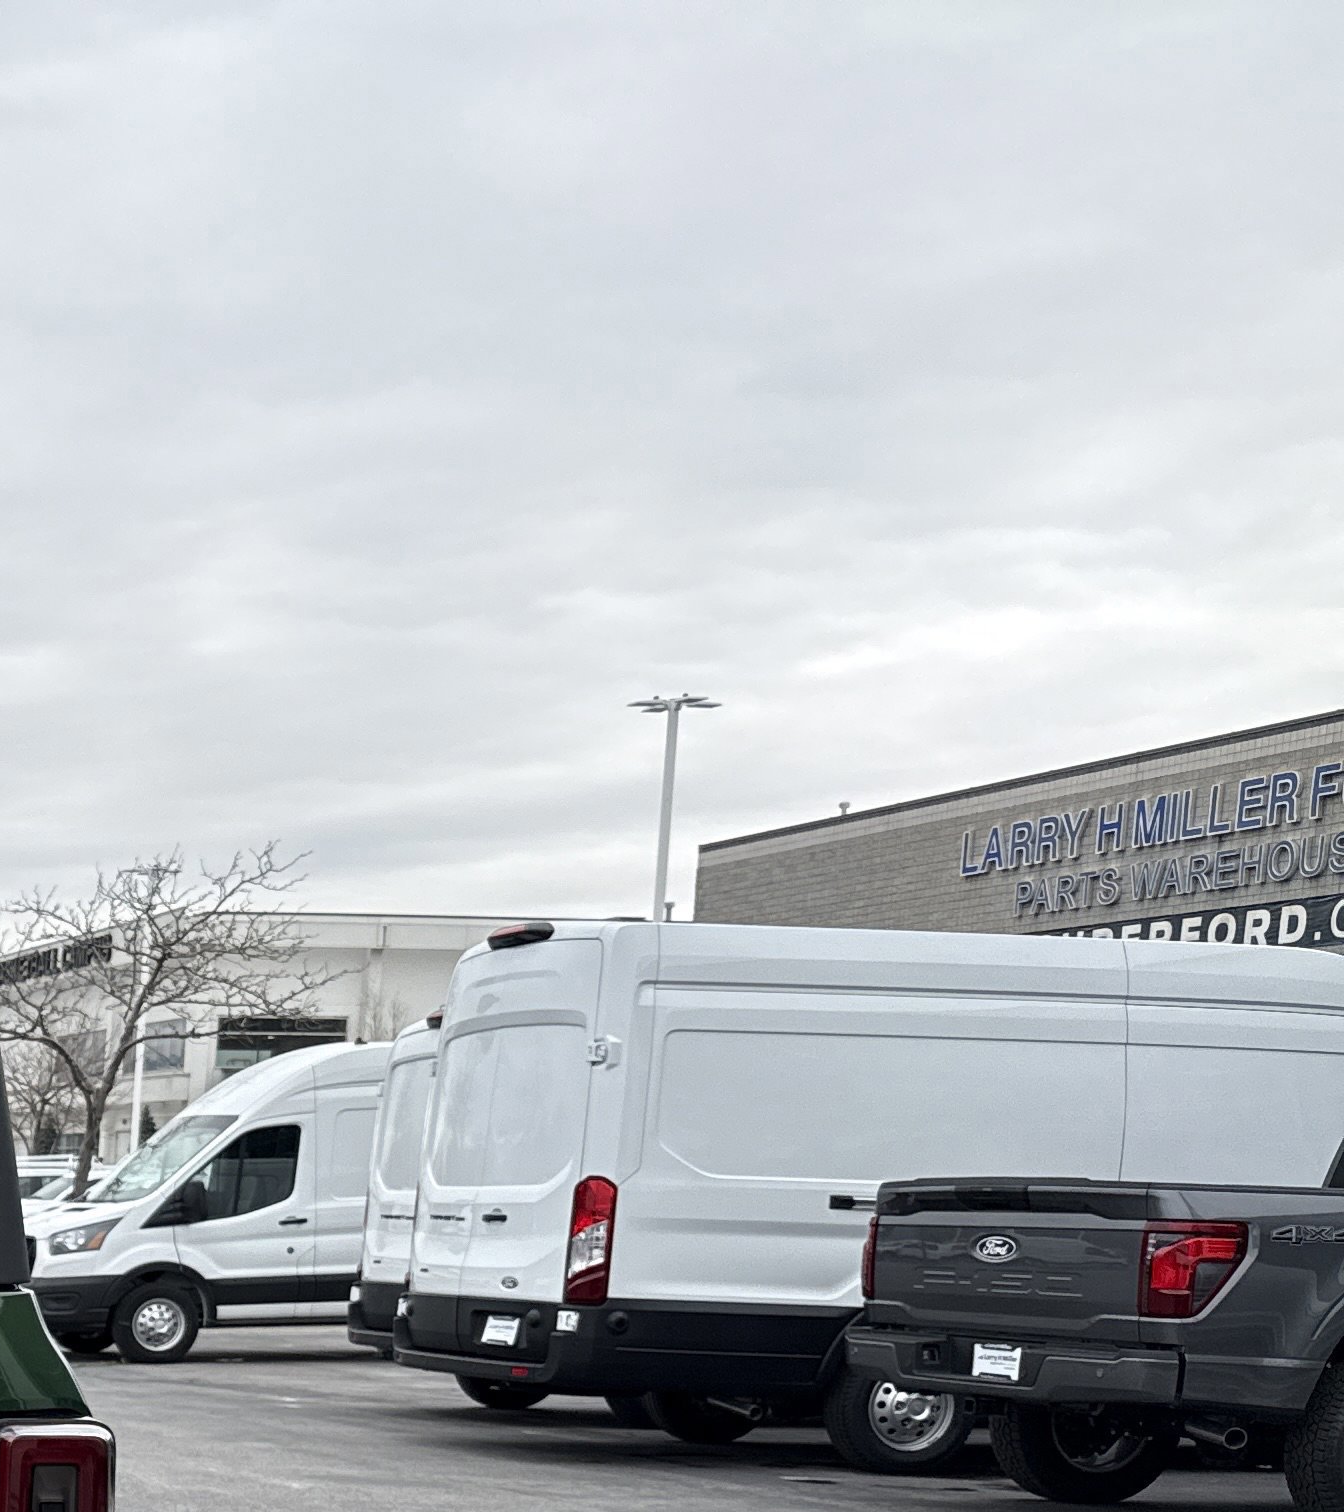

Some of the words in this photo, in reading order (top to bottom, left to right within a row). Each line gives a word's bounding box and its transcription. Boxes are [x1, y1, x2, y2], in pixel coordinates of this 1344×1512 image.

[960, 808, 1091, 877] LARRY
[1095, 802, 1124, 855] H
[1132, 770, 1300, 848] MILLER
[1310, 762, 1344, 820] F
[1014, 867, 1122, 915] PARTS
[1045, 899, 1344, 946] RFORD.
